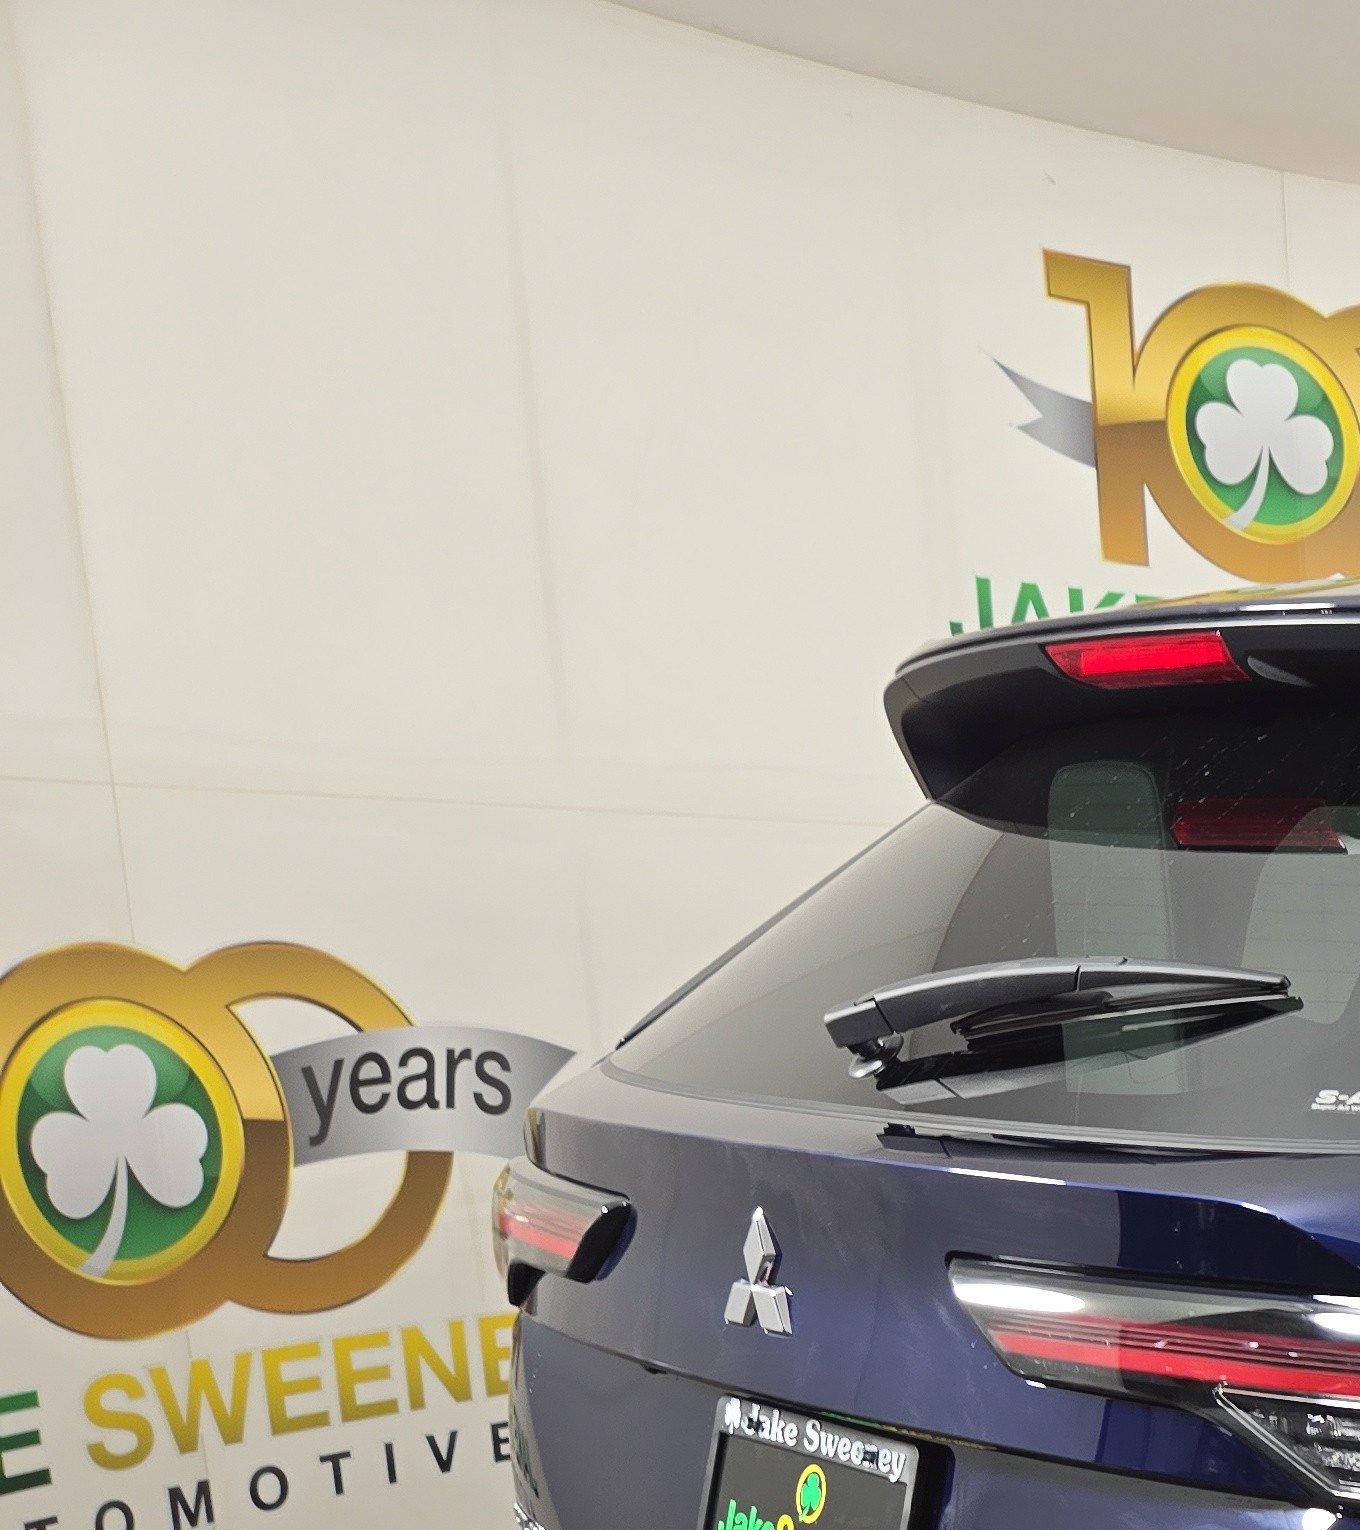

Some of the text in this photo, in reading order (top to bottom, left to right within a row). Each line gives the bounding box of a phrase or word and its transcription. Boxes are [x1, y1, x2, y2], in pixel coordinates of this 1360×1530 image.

[301, 1044, 512, 1147] years
[83, 1312, 518, 1471] SWEENE
[740, 1402, 798, 1447] Jake
